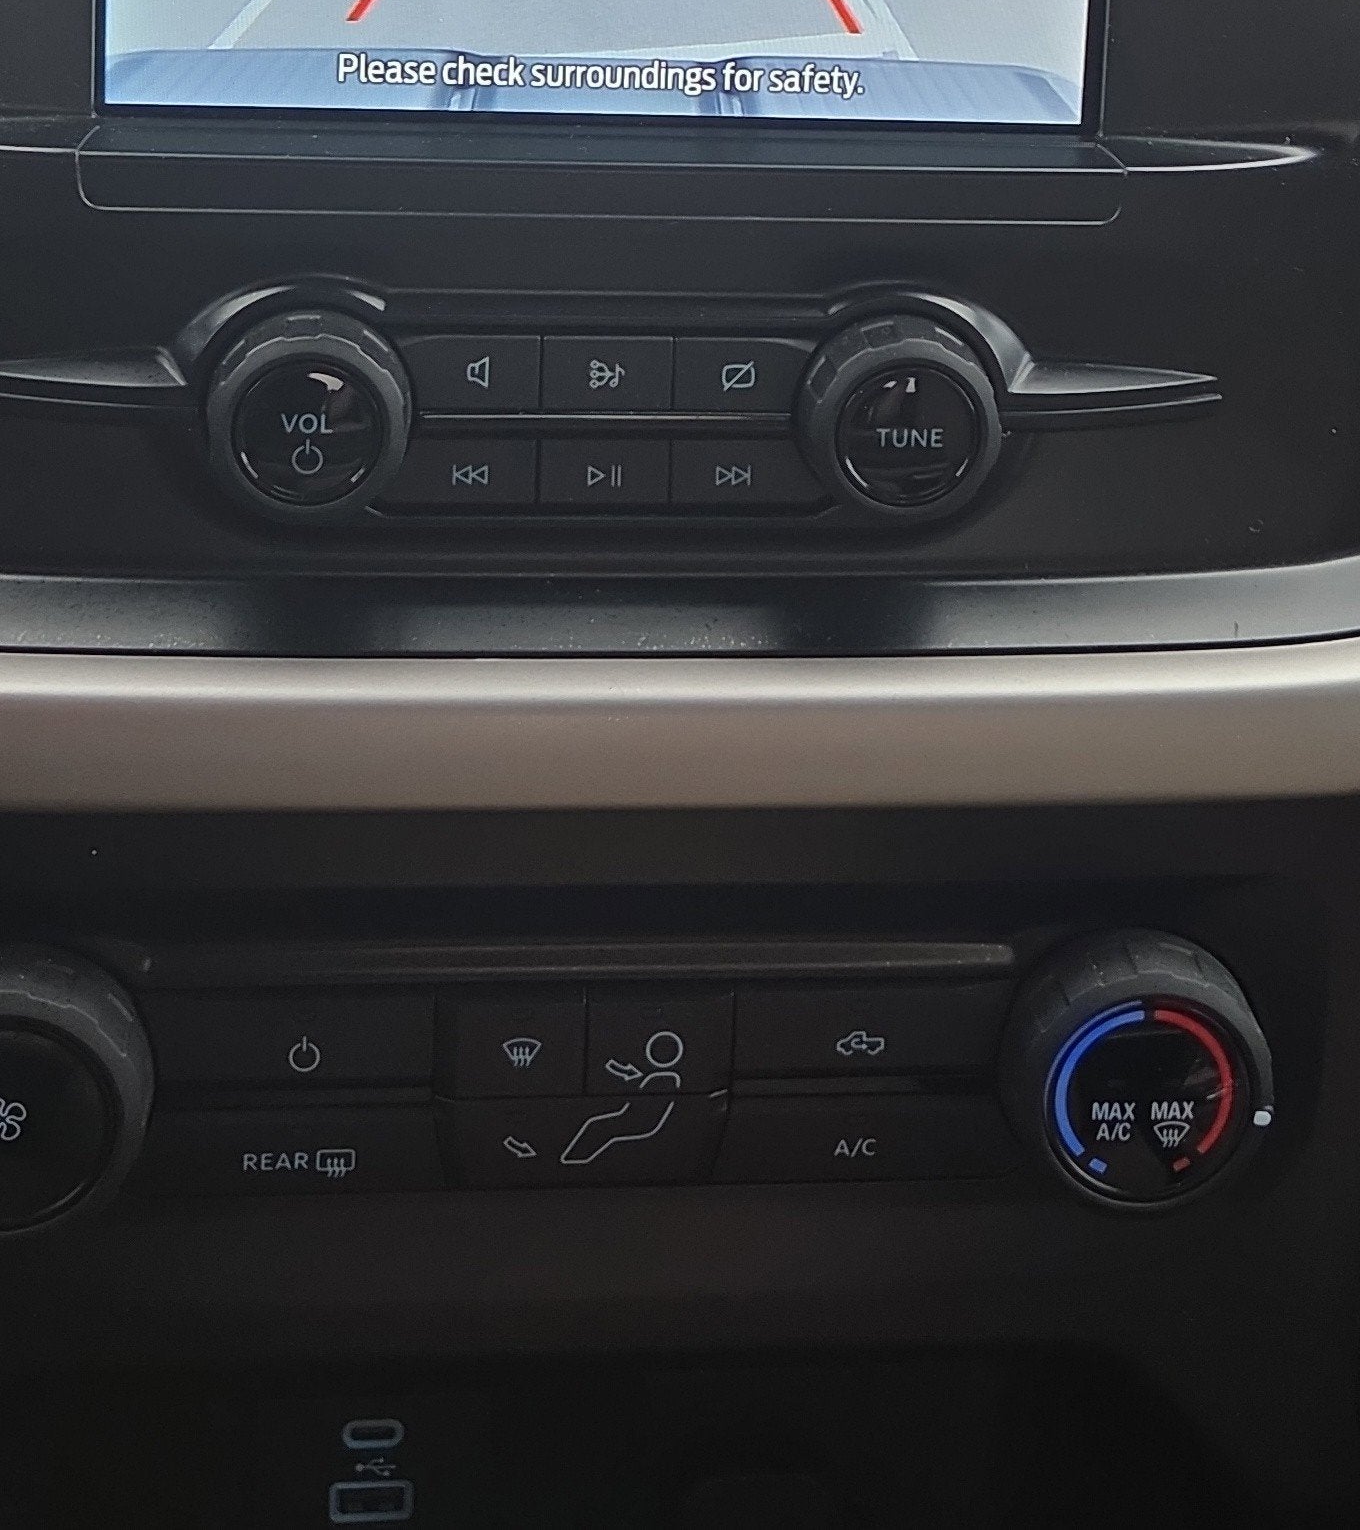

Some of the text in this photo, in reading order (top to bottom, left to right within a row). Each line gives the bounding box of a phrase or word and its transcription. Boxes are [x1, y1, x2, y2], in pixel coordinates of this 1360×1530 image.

[337, 52, 865, 99] Please check surroundings for safety.
[280, 413, 333, 435] VOL
[876, 427, 943, 449] TUNE
[1091, 1100, 1195, 1121] MAX MAX
[1095, 1122, 1131, 1141] A/C
[834, 1135, 877, 1158] A/C
[242, 1151, 309, 1172] REAR
